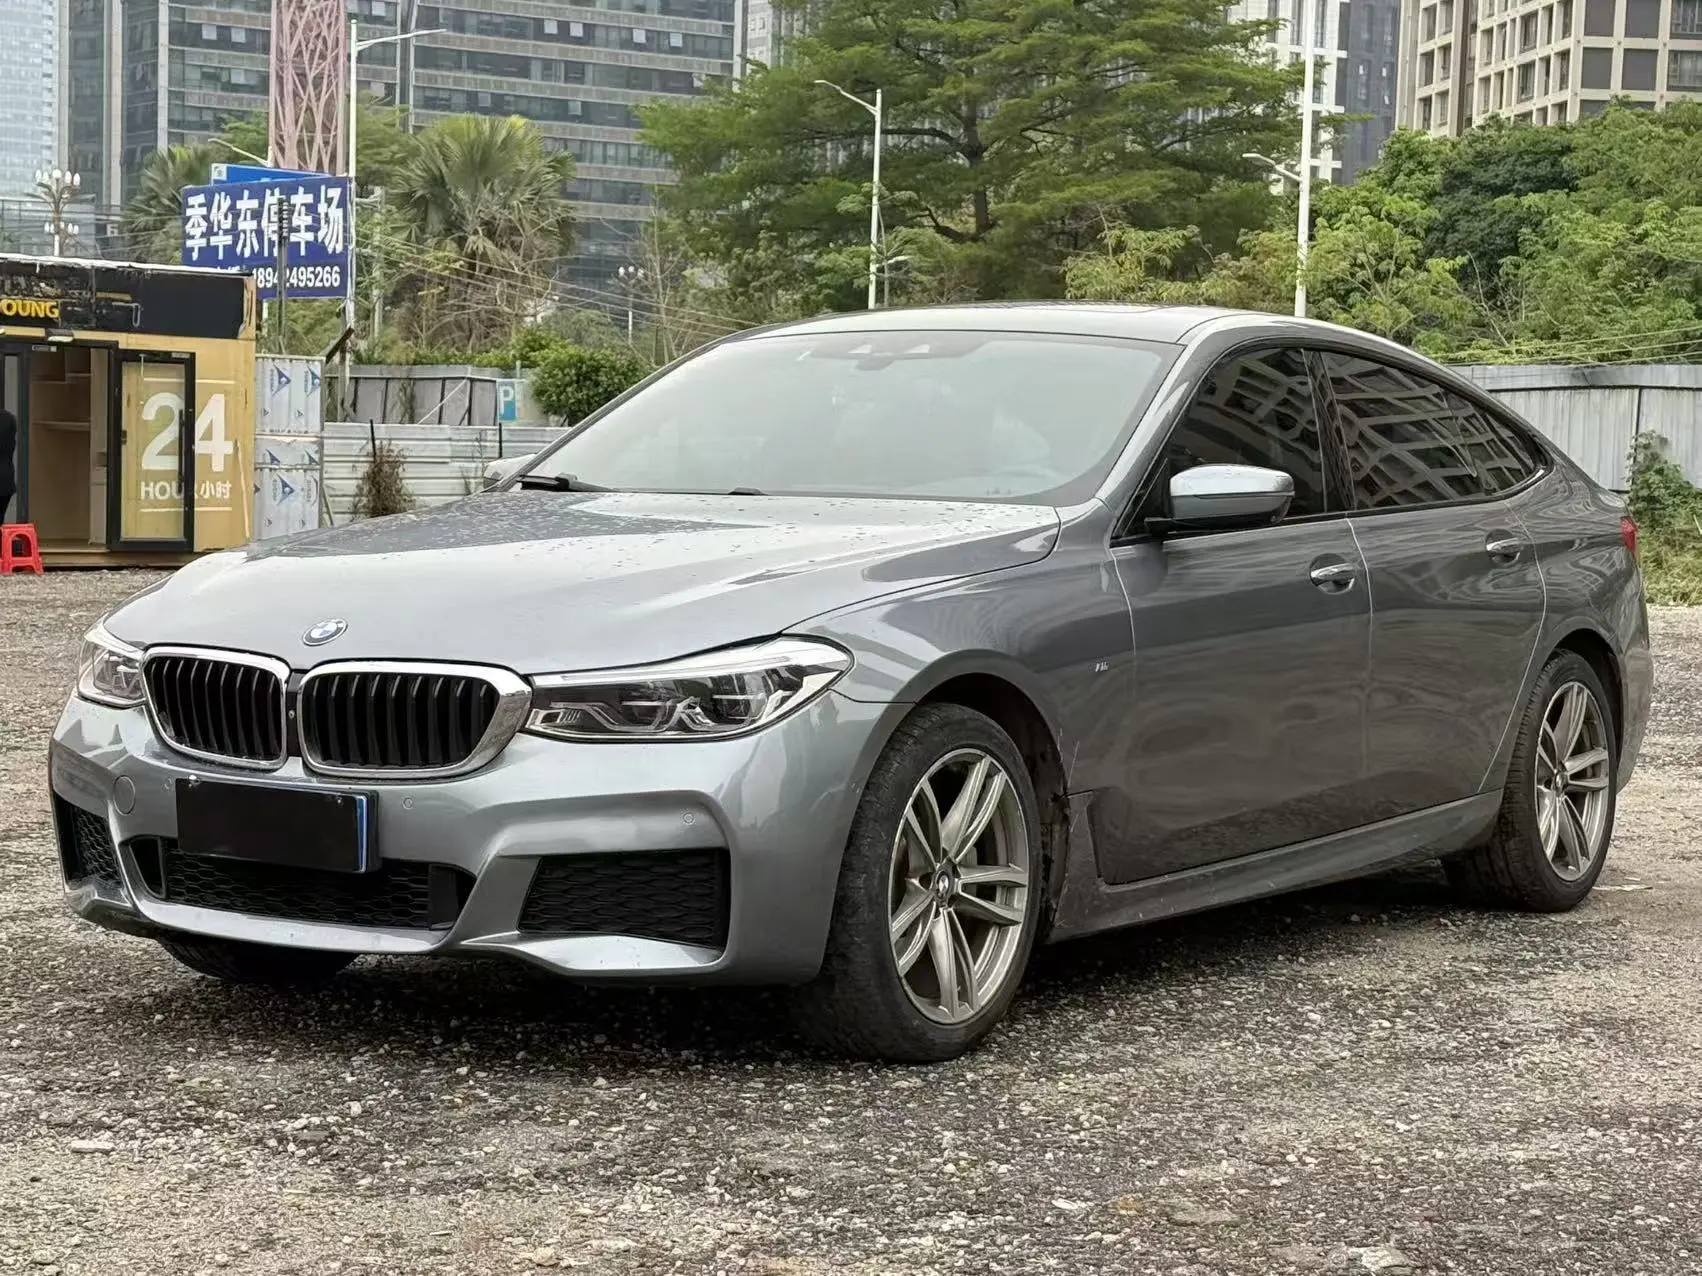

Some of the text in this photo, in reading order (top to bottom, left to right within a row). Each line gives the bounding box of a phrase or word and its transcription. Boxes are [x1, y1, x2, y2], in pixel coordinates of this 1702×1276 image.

[185, 184, 344, 261] 季华东停车场
[499, 385, 514, 415] P
[141, 392, 234, 473] 24
[140, 481, 232, 500] HOU 小时
